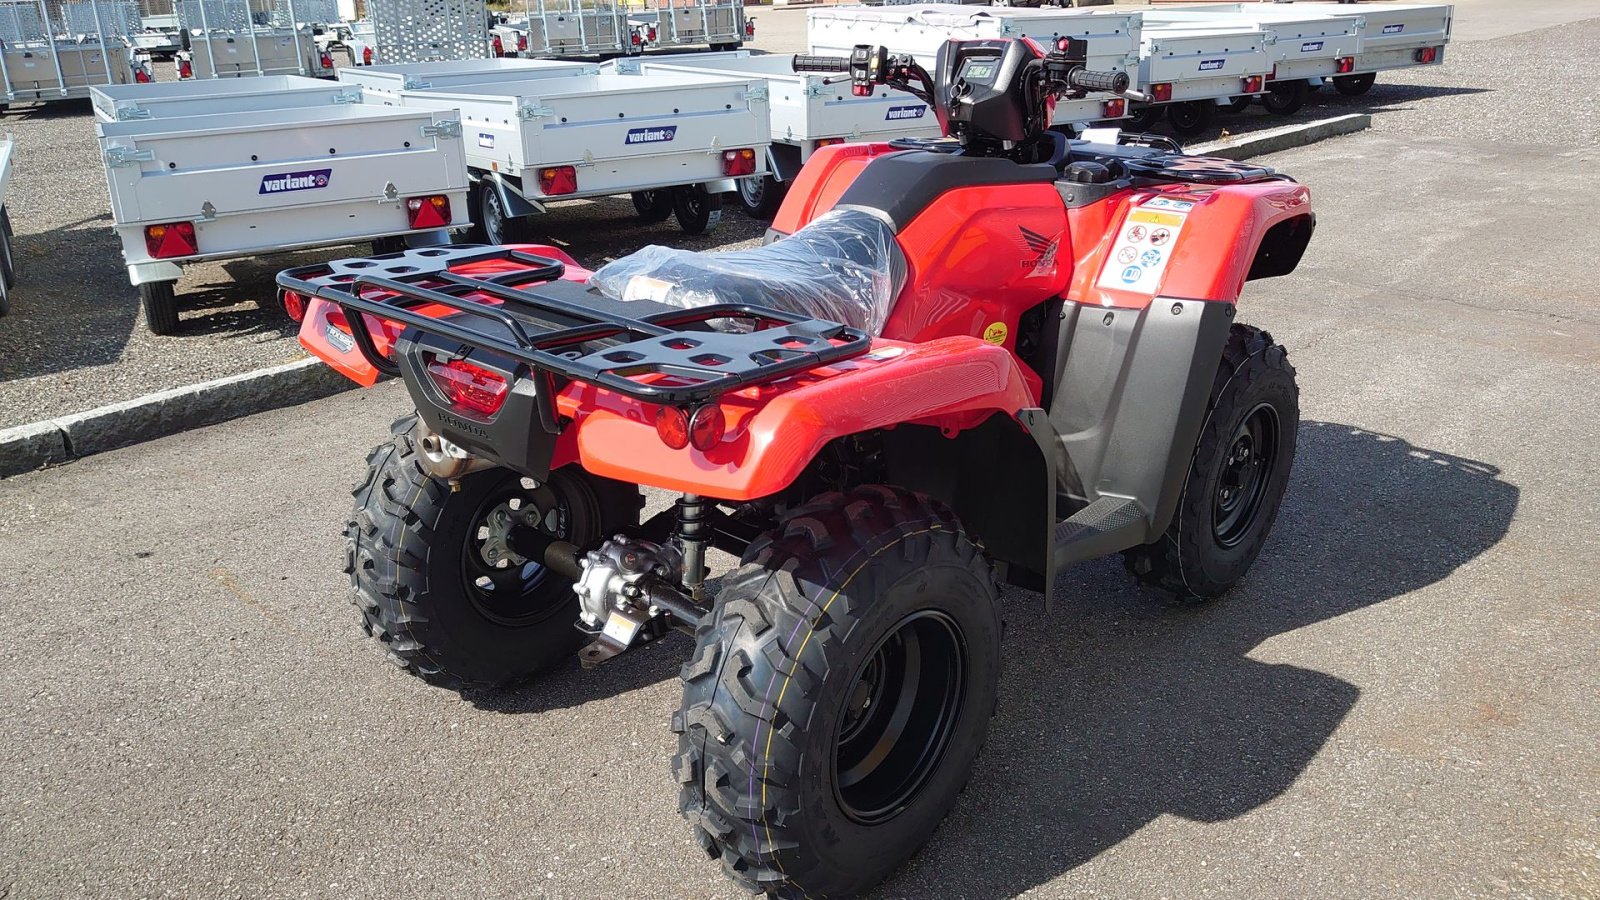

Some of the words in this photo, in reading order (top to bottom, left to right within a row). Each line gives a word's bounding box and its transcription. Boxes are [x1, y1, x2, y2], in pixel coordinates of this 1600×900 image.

[1201, 61, 1219, 70] variant
[889, 107, 917, 119] variant
[629, 129, 665, 143] variant
[264, 174, 315, 192] variant
[1020, 259, 1060, 268] HONDA
[437, 412, 491, 439] HONDA
